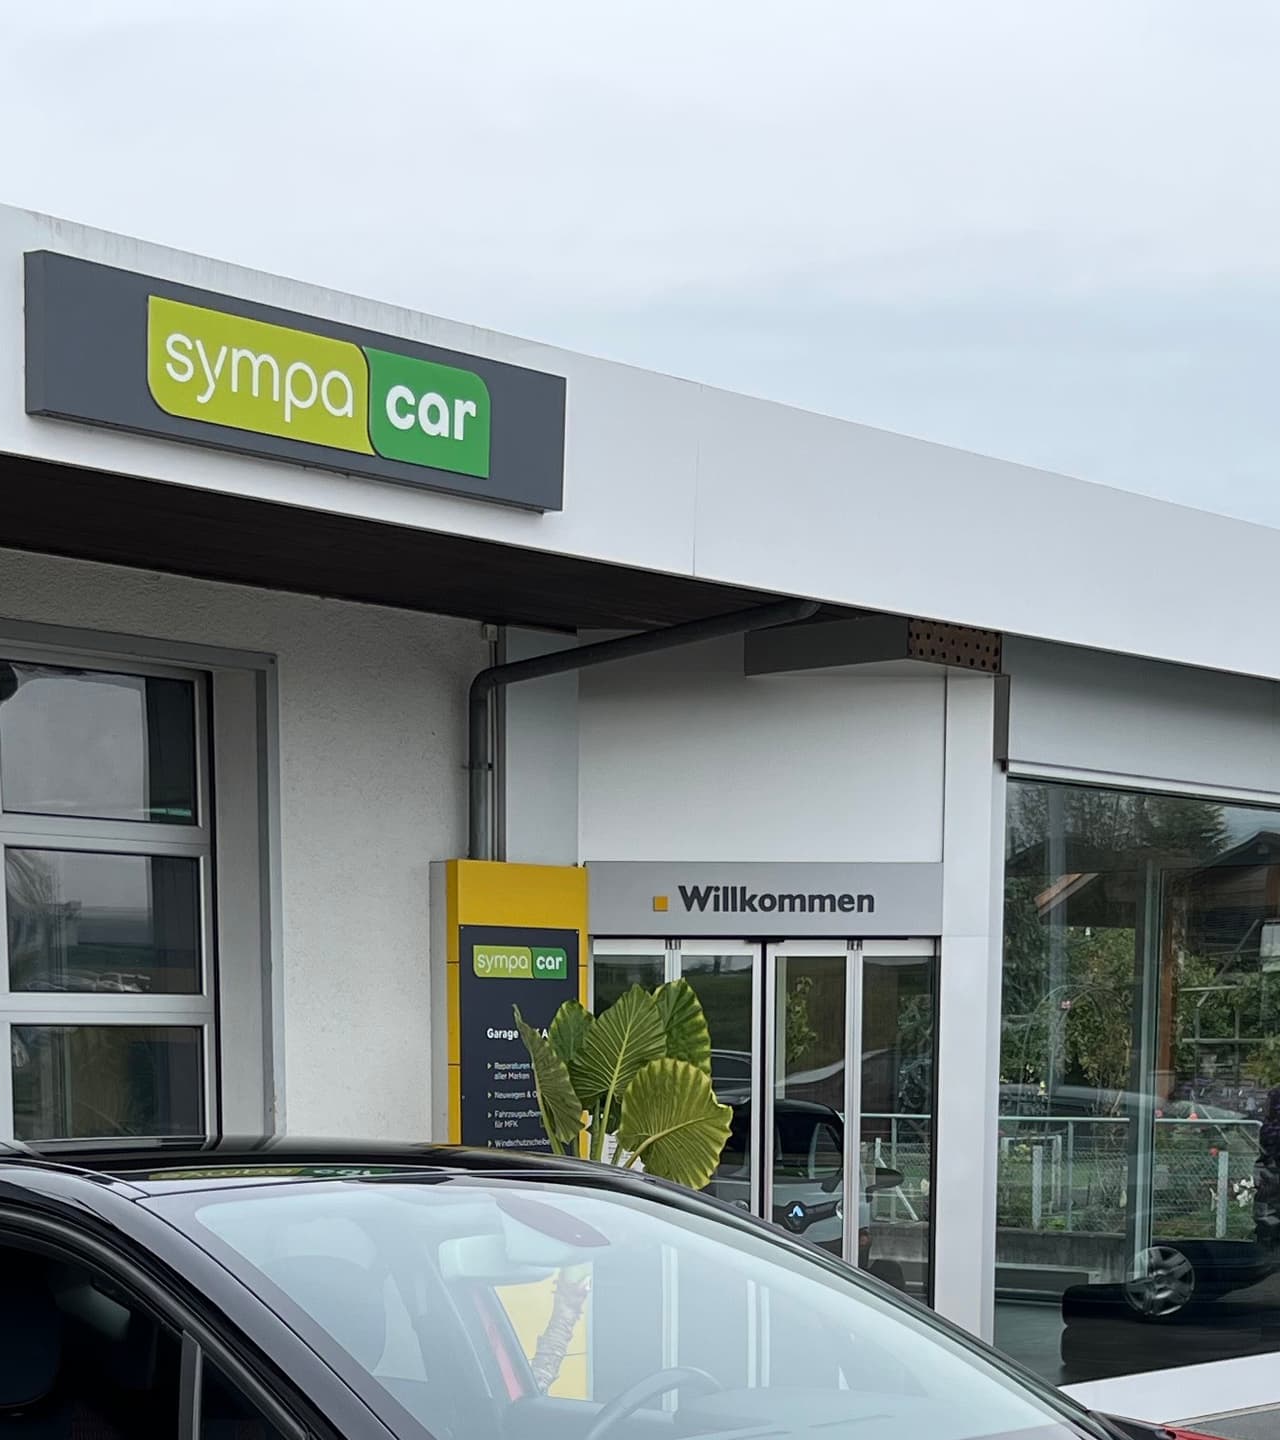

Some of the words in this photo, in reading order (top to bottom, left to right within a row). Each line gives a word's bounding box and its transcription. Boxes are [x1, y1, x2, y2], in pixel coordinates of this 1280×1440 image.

[164, 332, 354, 423] sympa
[385, 384, 478, 441] car
[677, 884, 876, 913] Willkommen
[477, 953, 529, 974] sympa
[535, 955, 563, 970] car
[486, 1027, 519, 1041] Garage
